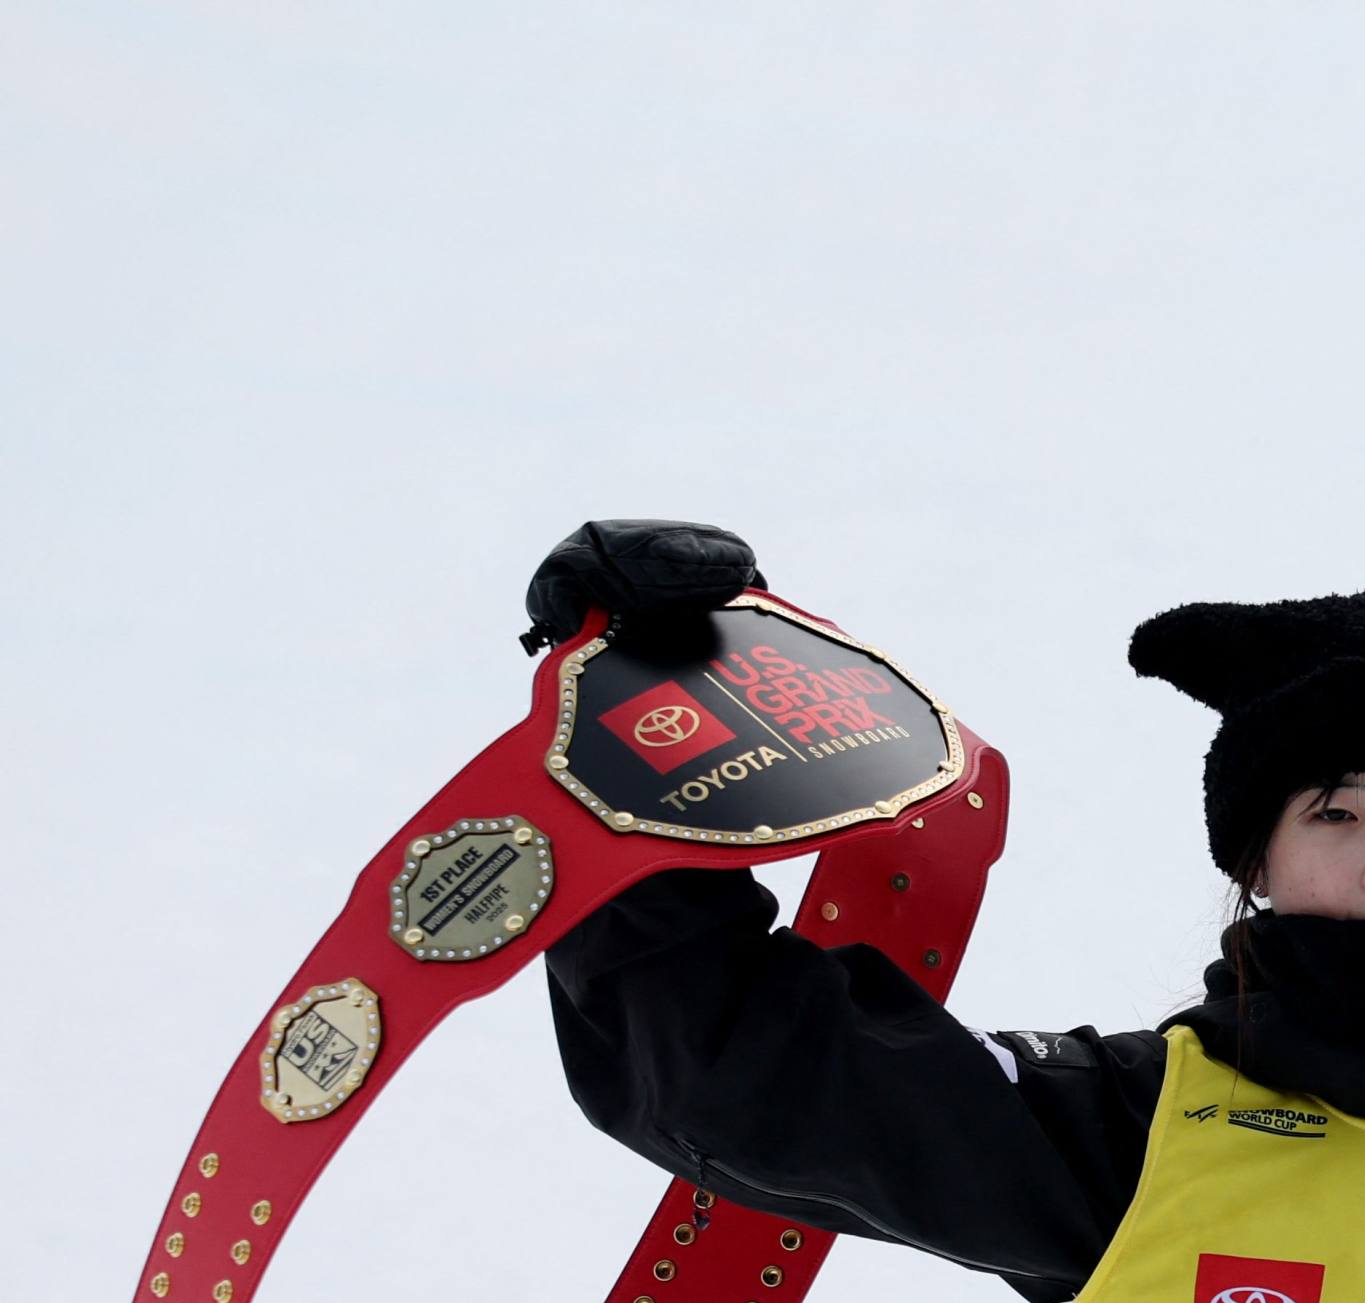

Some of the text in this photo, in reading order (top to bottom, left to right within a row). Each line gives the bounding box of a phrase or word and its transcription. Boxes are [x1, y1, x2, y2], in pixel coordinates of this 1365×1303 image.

[708, 645, 807, 688] U.S.
[746, 665, 892, 715] GRAND
[774, 698, 895, 744] PRIX
[808, 725, 911, 760] SNOWBOARD
[659, 745, 787, 813] TOYOTA
[421, 846, 483, 902] 1ST PLACE
[462, 849, 514, 896] SNOWBOARD
[464, 883, 510, 924] HALFPIPE
[1229, 1112, 1297, 1131] WORLD CUP
